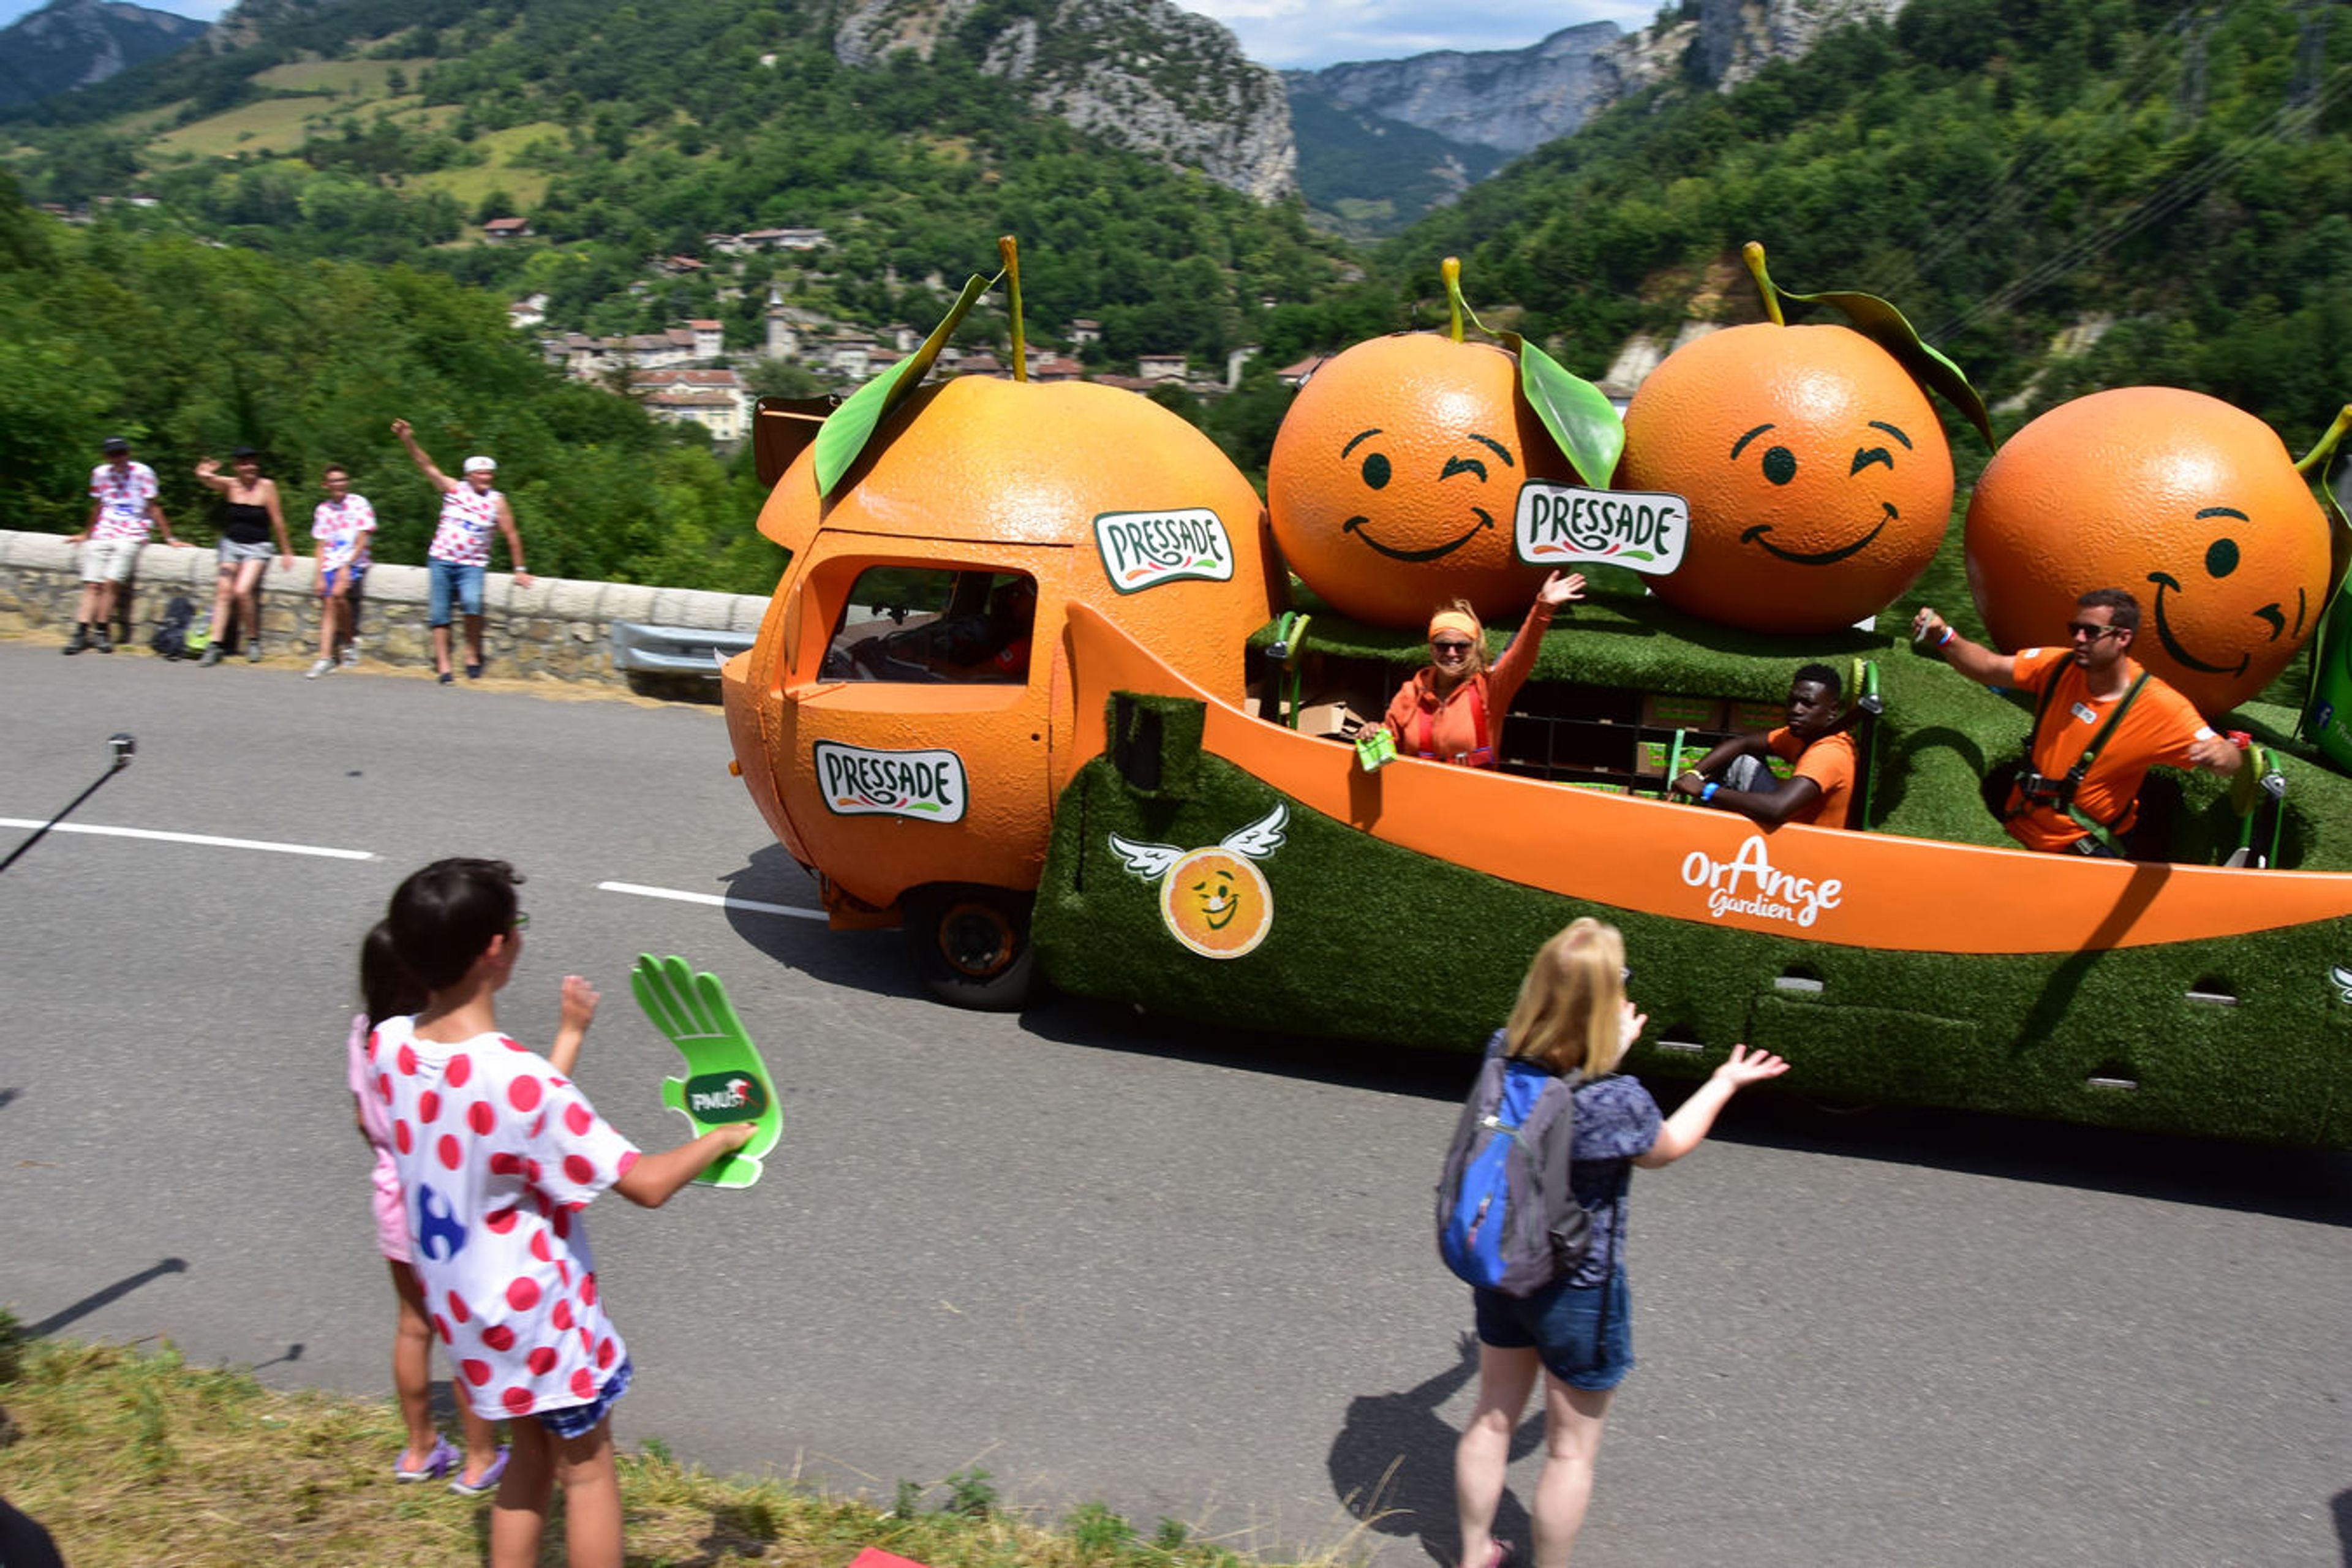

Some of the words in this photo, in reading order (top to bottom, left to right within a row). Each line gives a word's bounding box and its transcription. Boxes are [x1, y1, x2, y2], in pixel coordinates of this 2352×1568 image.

[1107, 519, 1224, 571] PRESSADE
[1530, 494, 1675, 555] PRESSADE
[826, 753, 952, 805] PRESSADE
[1708, 888, 1795, 921] Gardien
[690, 1091, 731, 1111] PMU
